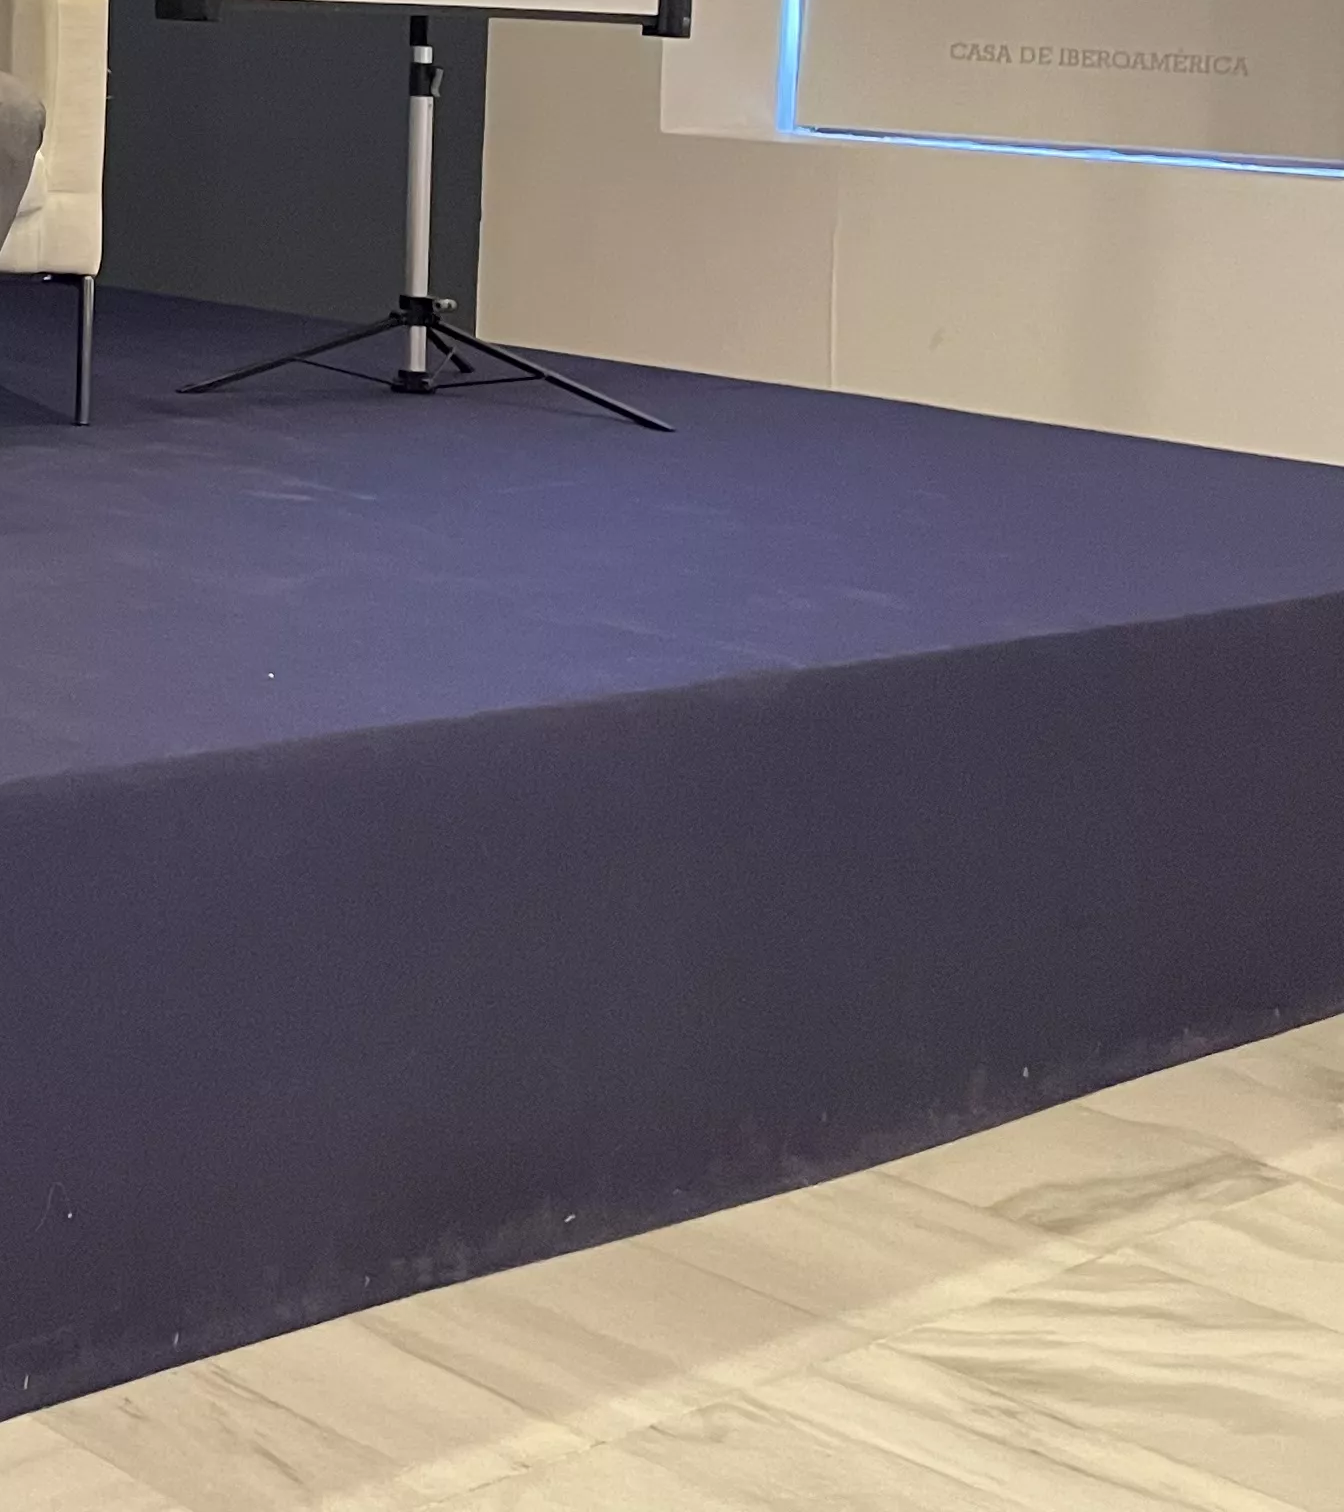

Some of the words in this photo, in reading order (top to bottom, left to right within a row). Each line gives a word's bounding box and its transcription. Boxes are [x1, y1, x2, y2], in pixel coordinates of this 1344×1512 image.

[950, 42, 1013, 64] CASA
[1019, 46, 1053, 65] DE
[1059, 48, 1249, 77] IBEROAMÉRICA
